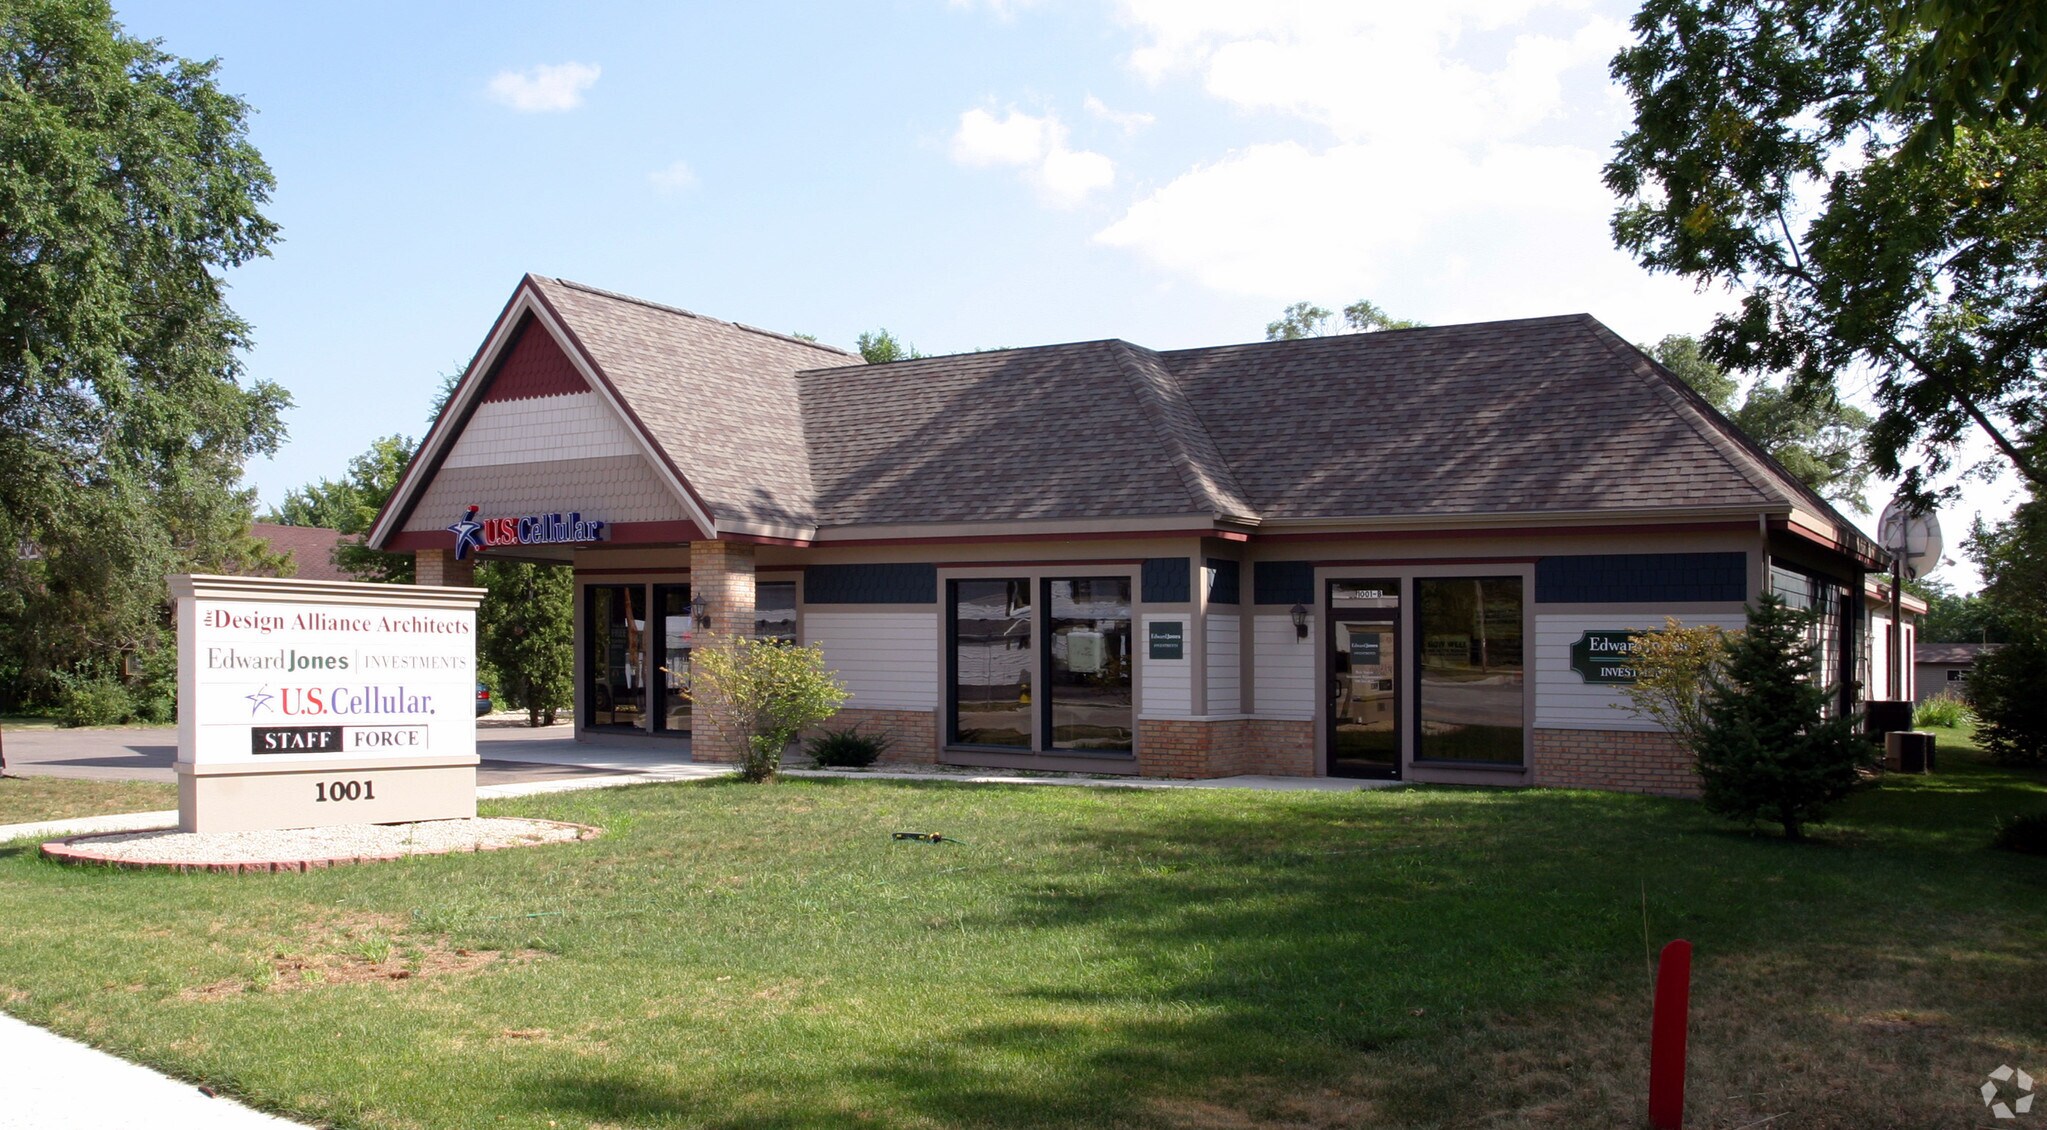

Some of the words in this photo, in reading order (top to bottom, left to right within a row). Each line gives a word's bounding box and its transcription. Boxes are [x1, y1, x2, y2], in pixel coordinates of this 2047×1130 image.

[484, 517, 518, 546] U.S.
[517, 512, 601, 544] Cellular
[203, 610, 213, 627] the
[215, 609, 284, 635] Design
[291, 613, 371, 632] Alliance
[377, 616, 469, 634] Architects
[208, 647, 285, 670] Edward
[287, 649, 349, 673] Jones
[365, 655, 467, 669] INVESTMENTS
[280, 687, 328, 716] U.S.
[265, 731, 332, 749] STAFF
[354, 731, 420, 747] FORCE
[315, 780, 375, 802] 1001
